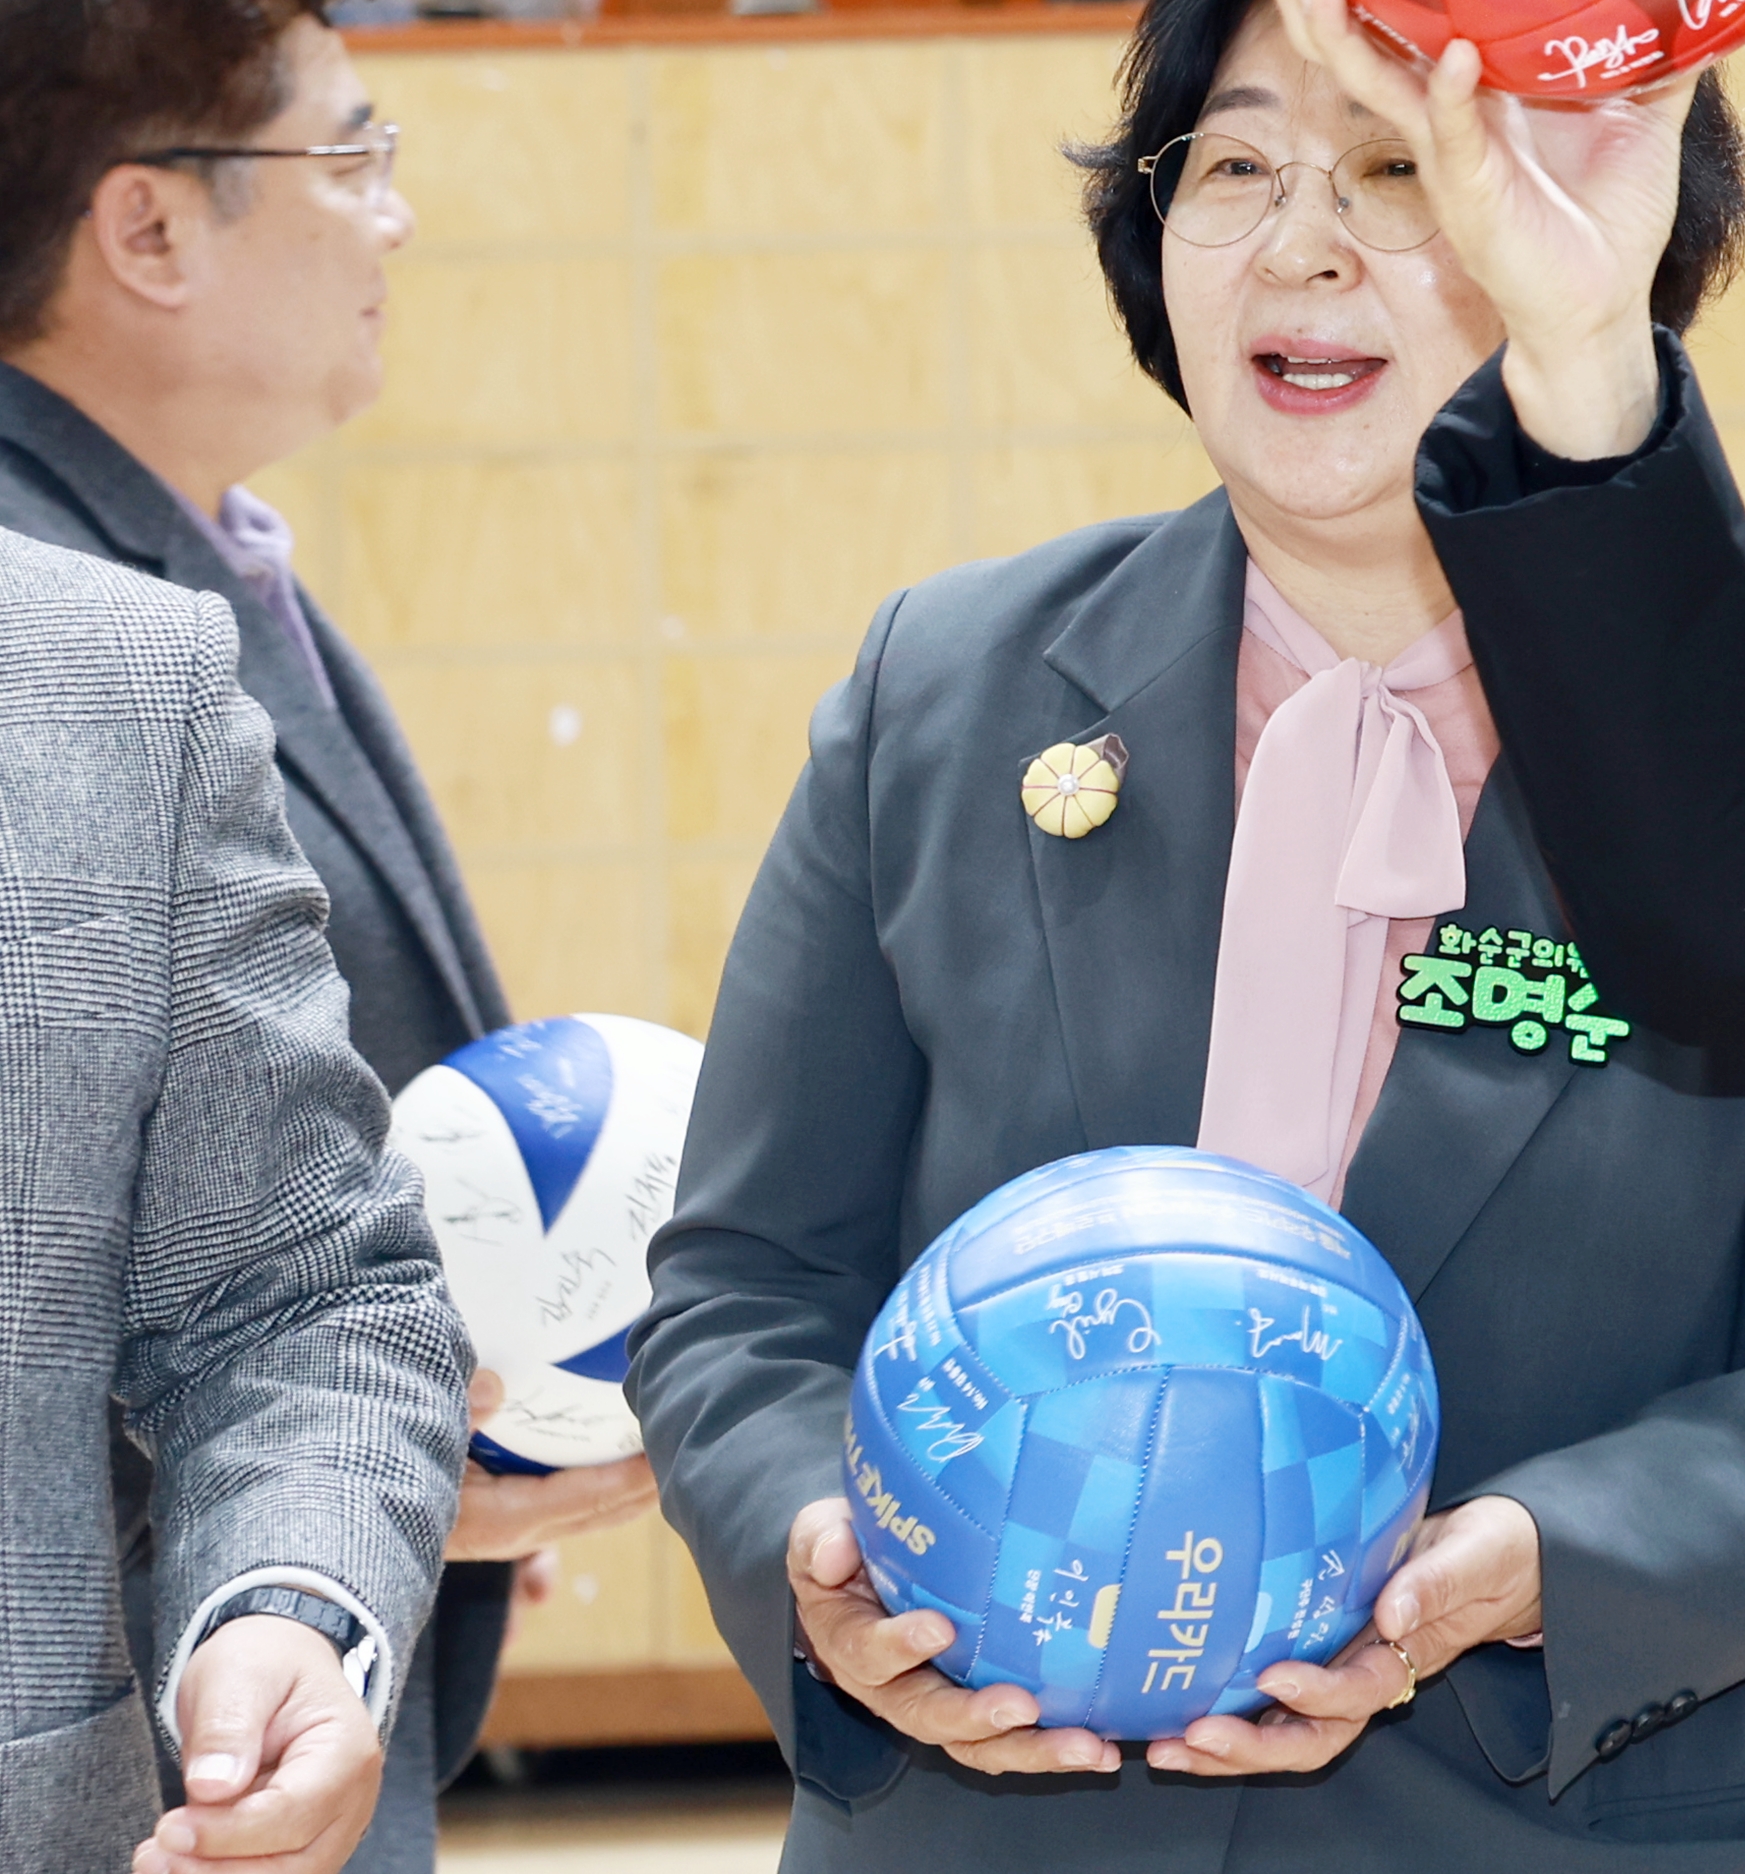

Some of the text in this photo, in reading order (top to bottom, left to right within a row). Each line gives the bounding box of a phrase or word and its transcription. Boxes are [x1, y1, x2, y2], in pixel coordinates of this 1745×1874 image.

[1399, 955, 1630, 1063] 조명순
[856, 1462, 937, 1556] SPIKE
[1140, 1530, 1224, 1695] 우리카드
